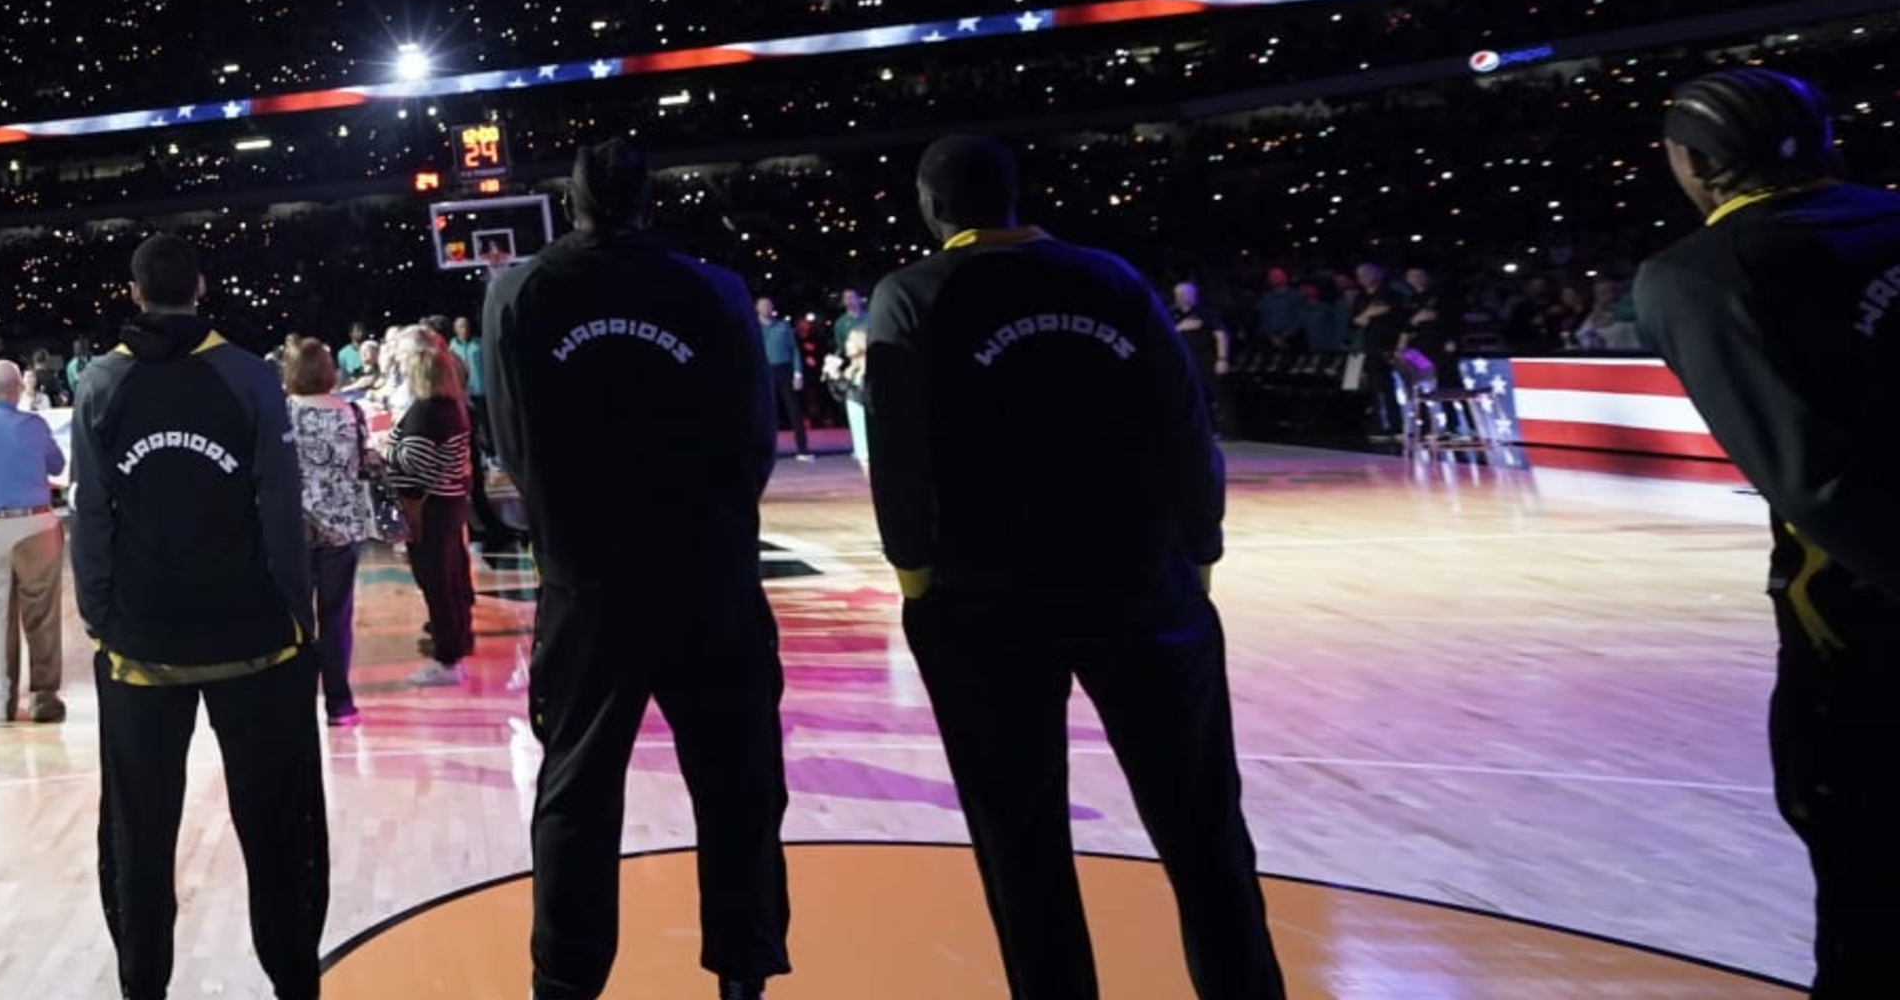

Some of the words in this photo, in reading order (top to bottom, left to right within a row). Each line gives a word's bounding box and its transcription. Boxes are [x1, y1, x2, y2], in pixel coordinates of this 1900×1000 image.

[465, 142, 498, 166] 24
[551, 317, 697, 365] WARRIORS
[973, 313, 1137, 367] WARRIORS
[116, 430, 240, 477] WARRIORS
